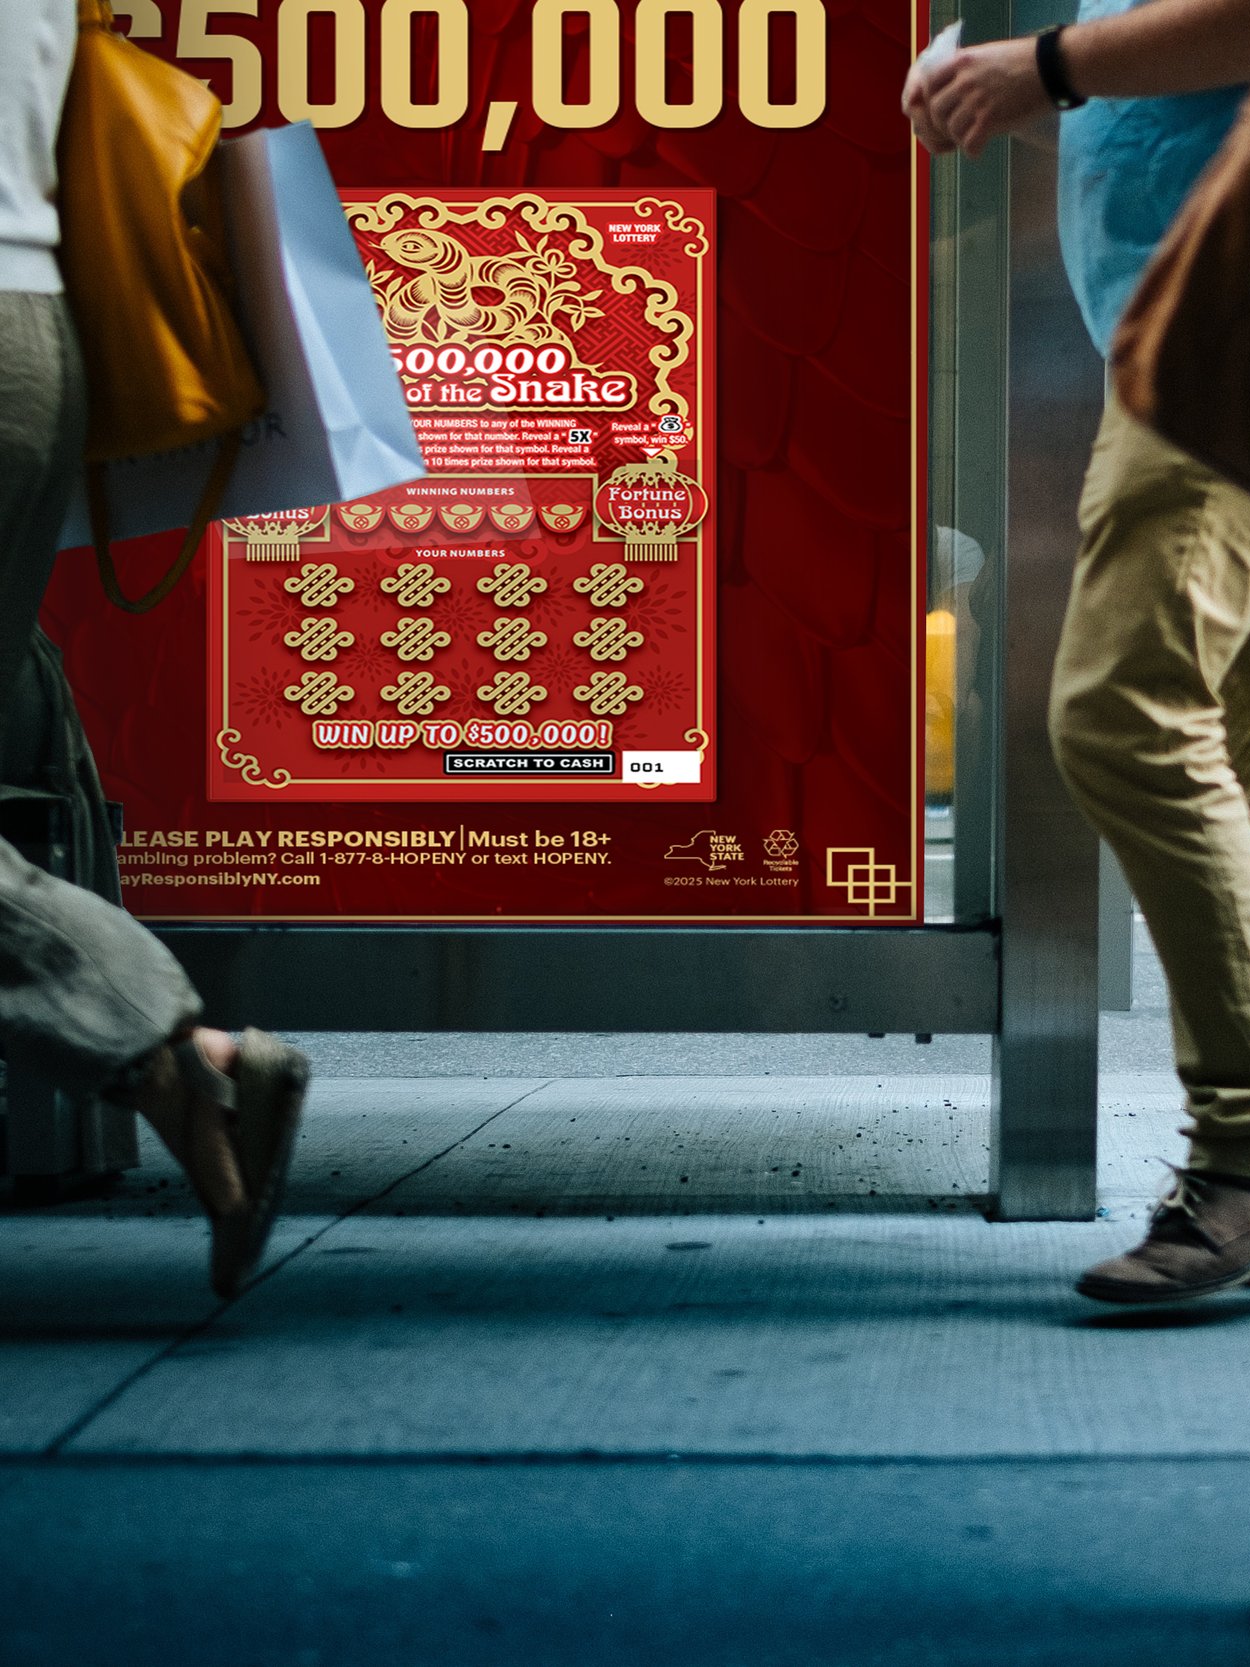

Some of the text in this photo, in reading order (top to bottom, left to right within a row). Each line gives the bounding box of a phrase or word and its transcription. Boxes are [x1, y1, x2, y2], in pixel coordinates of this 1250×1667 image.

[111, 0, 827, 151] 500,000
[608, 224, 661, 233] NEW YORK
[613, 234, 656, 242] LOTTERY
[406, 373, 626, 403] of the Snake
[410, 419, 577, 430] OUR NUMBERS to any of the WINNING
[611, 422, 641, 431] Reveal
[418, 432, 448, 441] shown
[449, 432, 462, 441] for
[464, 432, 482, 441] that
[484, 432, 520, 441] number.
[522, 432, 552, 441] Reveal
[570, 430, 590, 442] 5X
[614, 435, 688, 445] symbol, win $50.
[425, 444, 447, 454] prize
[449, 444, 479, 453] shown
[480, 444, 494, 453] for
[495, 444, 514, 453] that
[515, 444, 550, 455] symbol.
[551, 444, 582, 453] Reveal
[432, 458, 443, 466] 10
[444, 457, 469, 466] times
[471, 457, 494, 468] prize
[495, 457, 525, 466] shown
[527, 457, 540, 466] for
[541, 457, 560, 466] that
[561, 457, 597, 468] symbol.
[406, 487, 515, 496] WINNING NUMBERS
[608, 487, 686, 501] Fortune
[618, 505, 682, 519] Bonus
[416, 549, 506, 558] YOUR NUMBERS
[318, 723, 607, 745] WIN UP TO $500,000!
[453, 758, 604, 768] SCRATCH TO CASH
[630, 762, 664, 773] 001
[120, 830, 612, 848] LEASE PLAY RESPONSIBLY Must be 18+
[709, 835, 737, 844] NEW
[709, 844, 742, 852] YORK
[118, 851, 612, 867] ambling problem? Call 1-877-8-HOPENY or text HOPENY.
[709, 852, 745, 861] STATE
[120, 872, 321, 887] ayResponsiblyNY.com
[706, 877, 731, 886] New
[733, 877, 757, 886] York
[760, 877, 799, 887] Lottery
